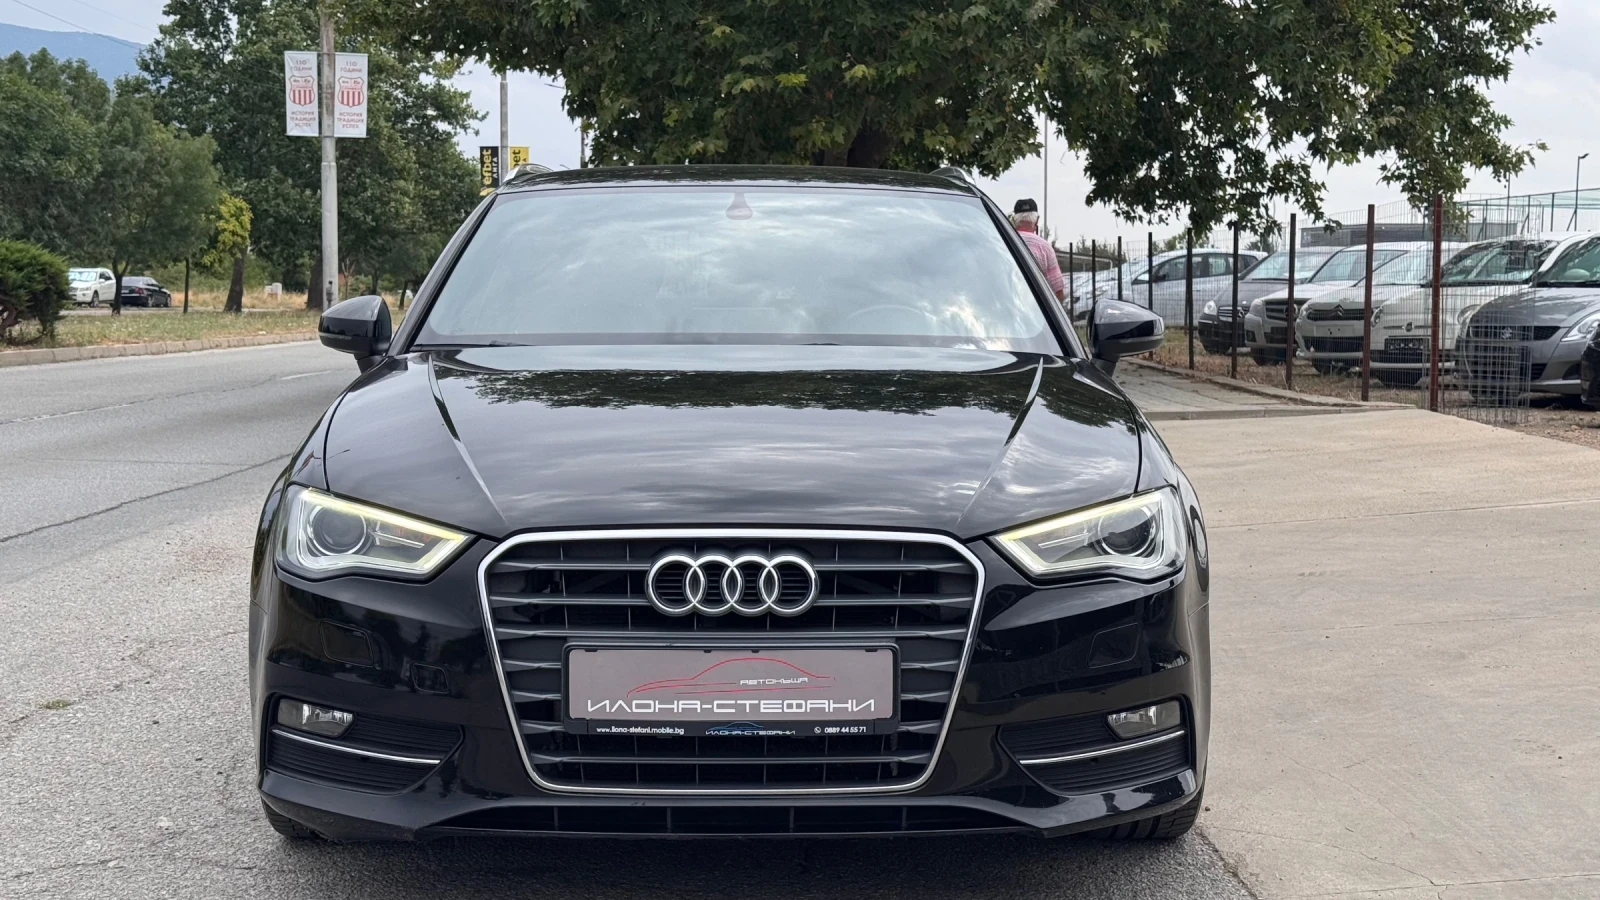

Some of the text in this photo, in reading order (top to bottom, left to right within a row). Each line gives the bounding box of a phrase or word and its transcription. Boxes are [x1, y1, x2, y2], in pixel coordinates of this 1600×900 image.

[482, 149, 492, 185] efbet
[587, 699, 875, 713] ИЛОНА-СТЕФАНИ
[596, 726, 685, 735] www.ilona-stefani.mobile.bg
